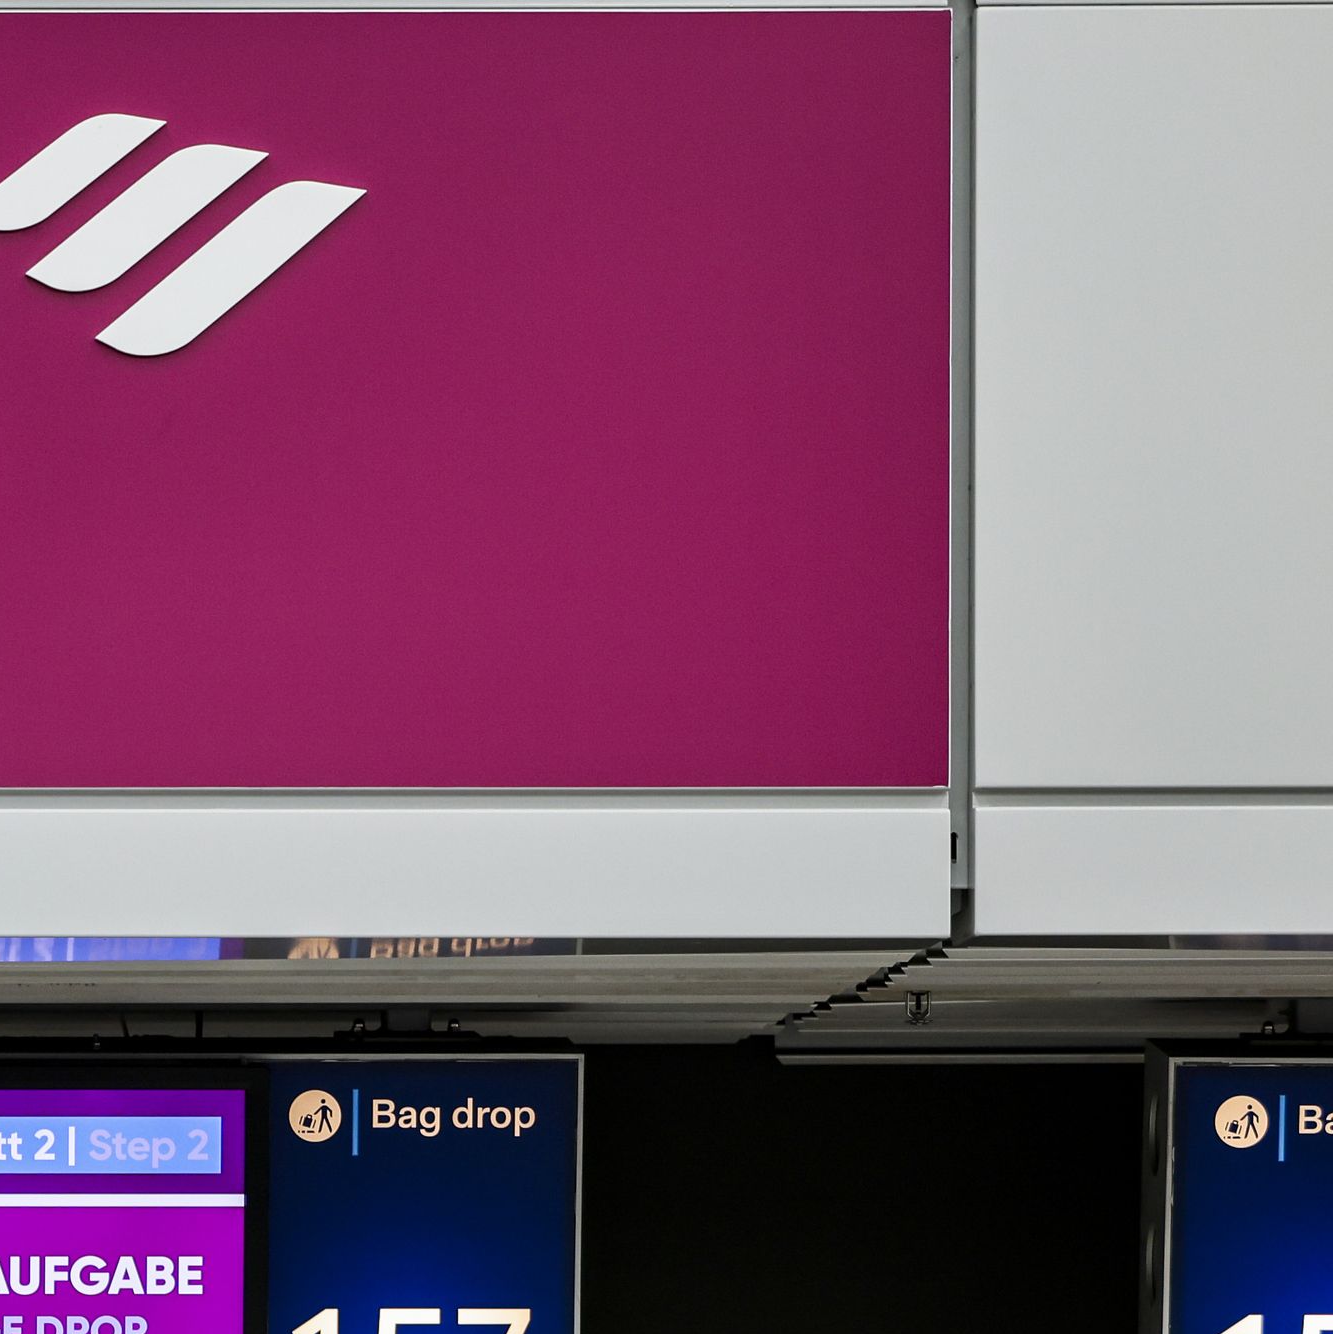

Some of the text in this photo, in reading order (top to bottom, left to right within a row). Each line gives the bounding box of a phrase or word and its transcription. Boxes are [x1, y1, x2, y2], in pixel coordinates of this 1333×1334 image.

[372, 1098, 536, 1138] Bag drop
[33, 1129, 56, 1161] 2
[89, 1129, 177, 1169] Step
[188, 1129, 209, 1161] 2
